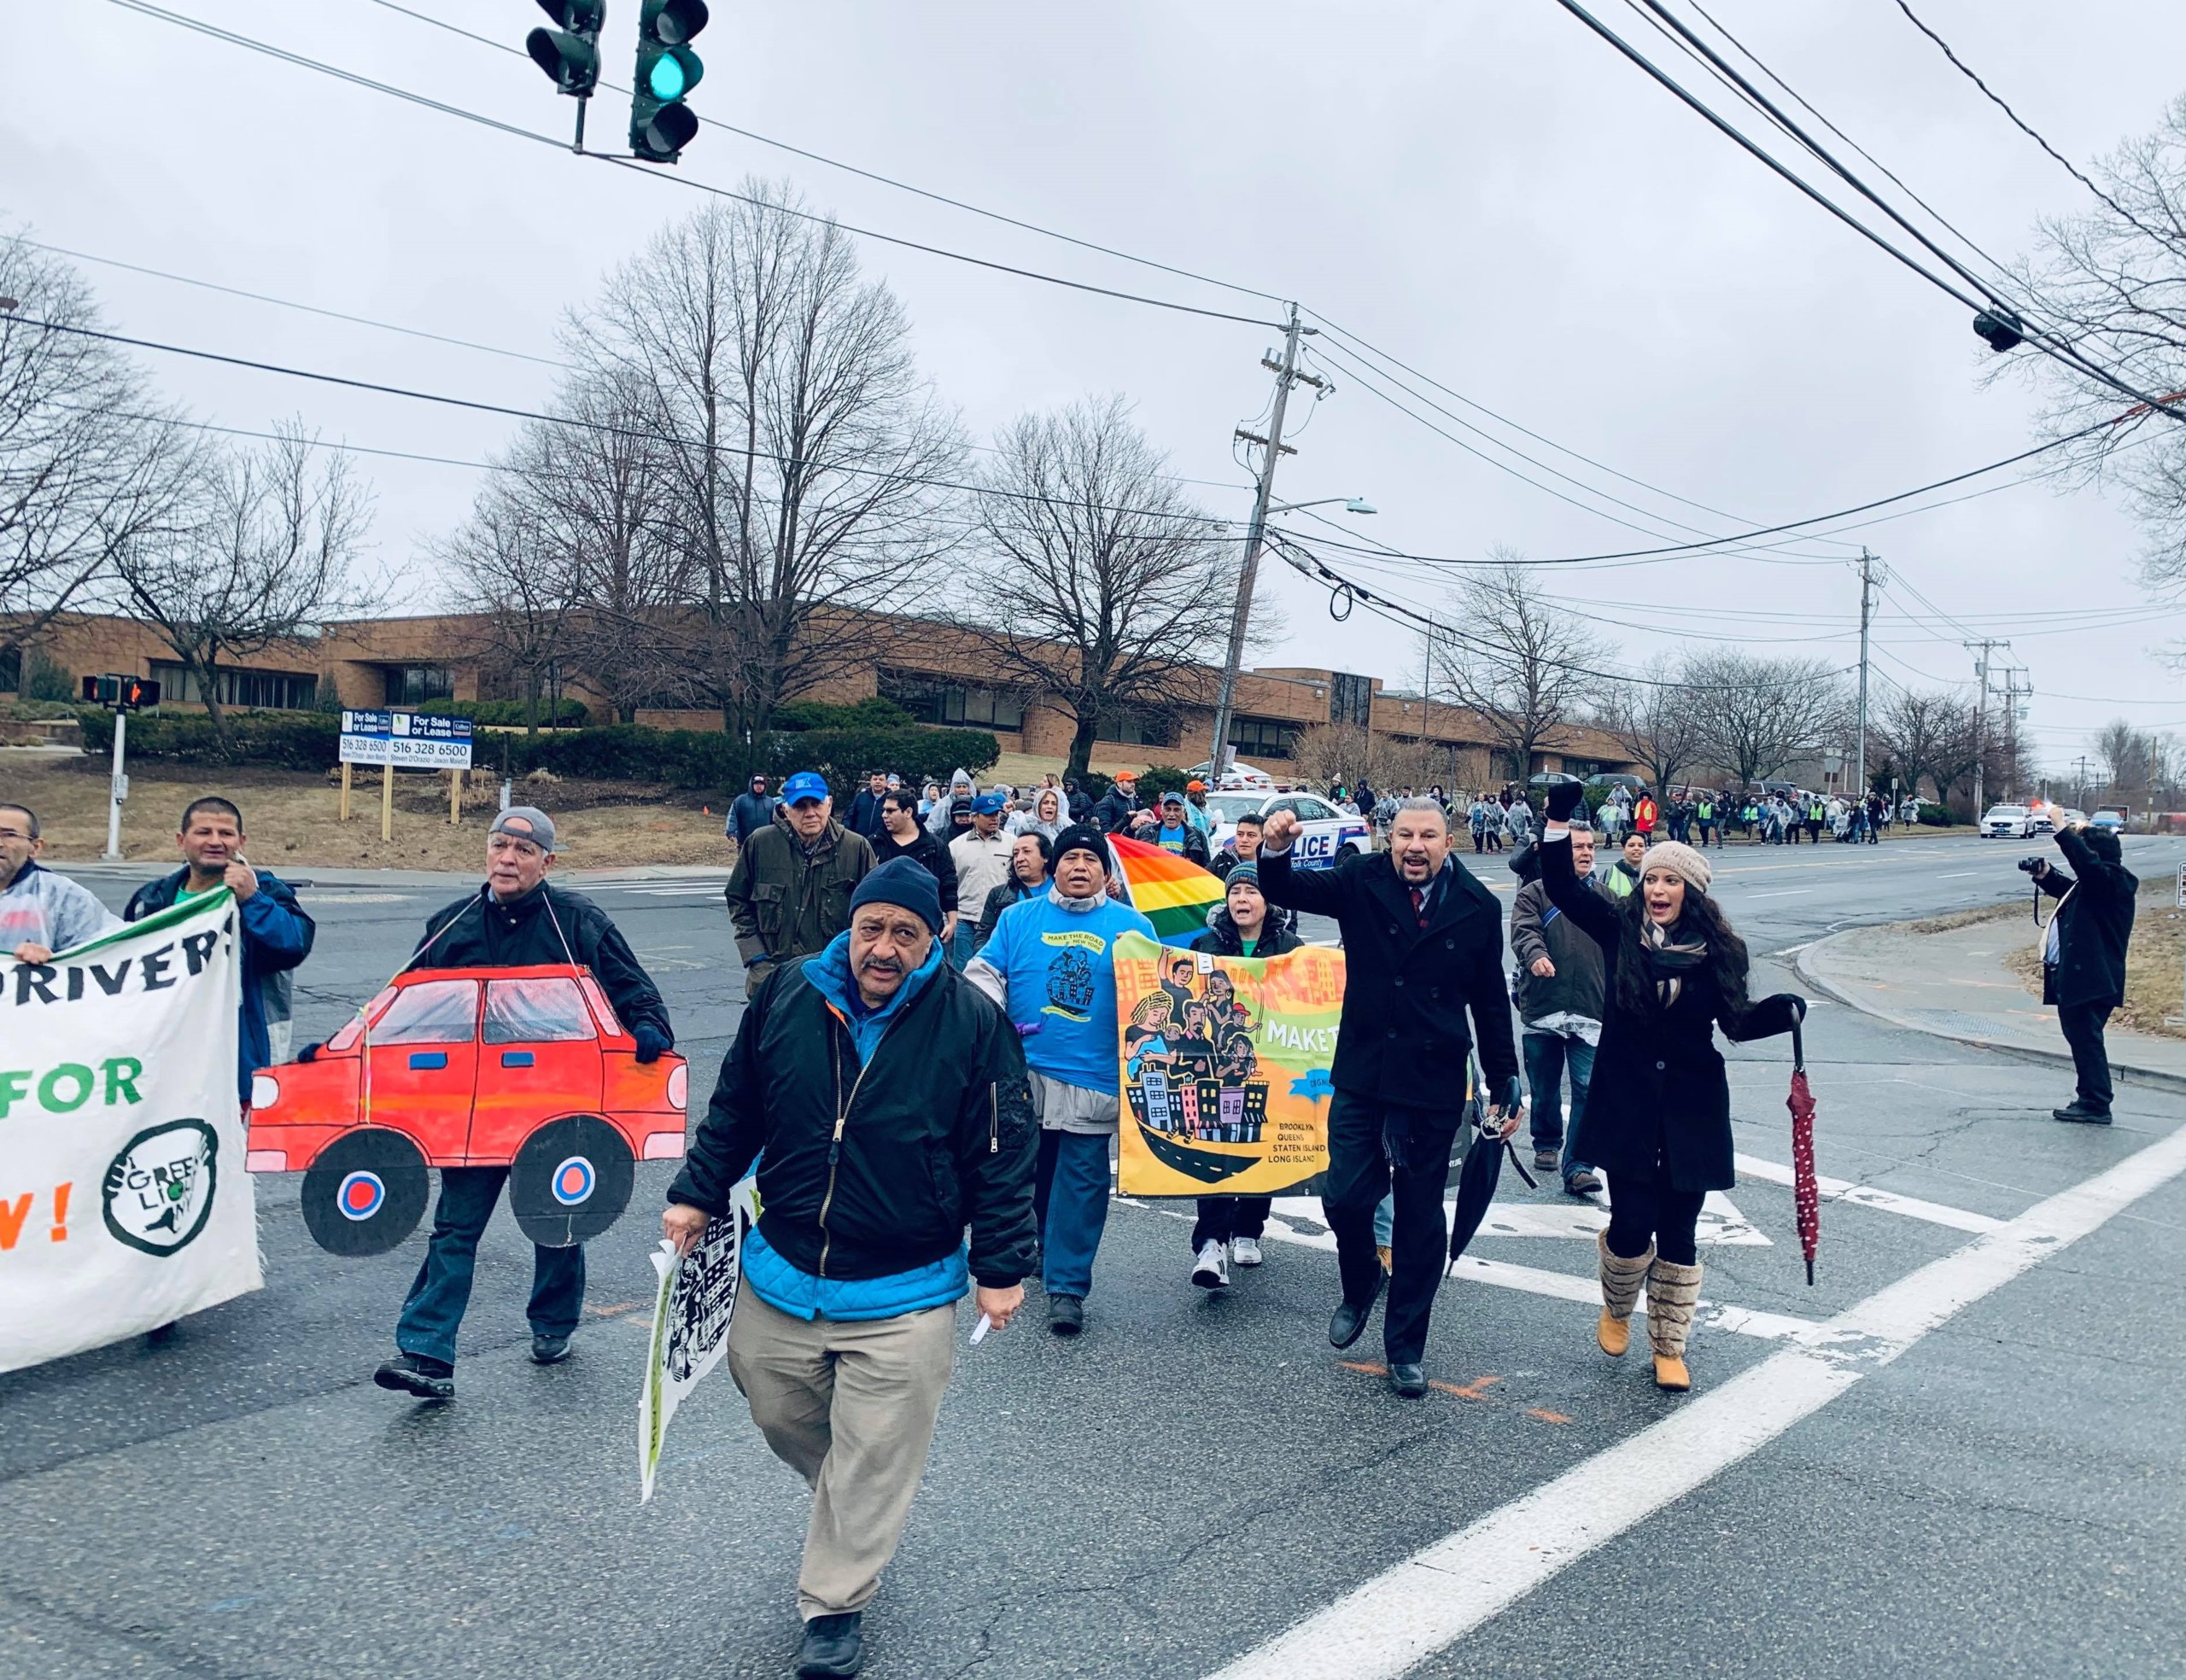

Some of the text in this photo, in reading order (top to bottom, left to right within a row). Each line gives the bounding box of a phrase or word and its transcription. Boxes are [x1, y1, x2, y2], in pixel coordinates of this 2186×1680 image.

[354, 712, 364, 722] For
[365, 712, 377, 723] Sale
[413, 715, 451, 728] For Sale
[353, 722, 377, 732] or Lease
[424, 726, 452, 738] Lease
[342, 738, 387, 752] 516 328 6500
[393, 742, 467, 756] 516 328 6500
[1291, 836, 1330, 858] LICE
[1291, 858, 1324, 868] folk County
[1084, 935, 1104, 947] ROAD
[1266, 1018, 1330, 1053] MAKE
[0, 1057, 143, 1120] FOR
[1279, 1123, 1314, 1131] BROOKLYN
[1277, 1134, 1304, 1142] QUEENS
[1272, 1144, 1326, 1152] STATEN ISLAND
[1268, 1155, 1291, 1164] LONG
